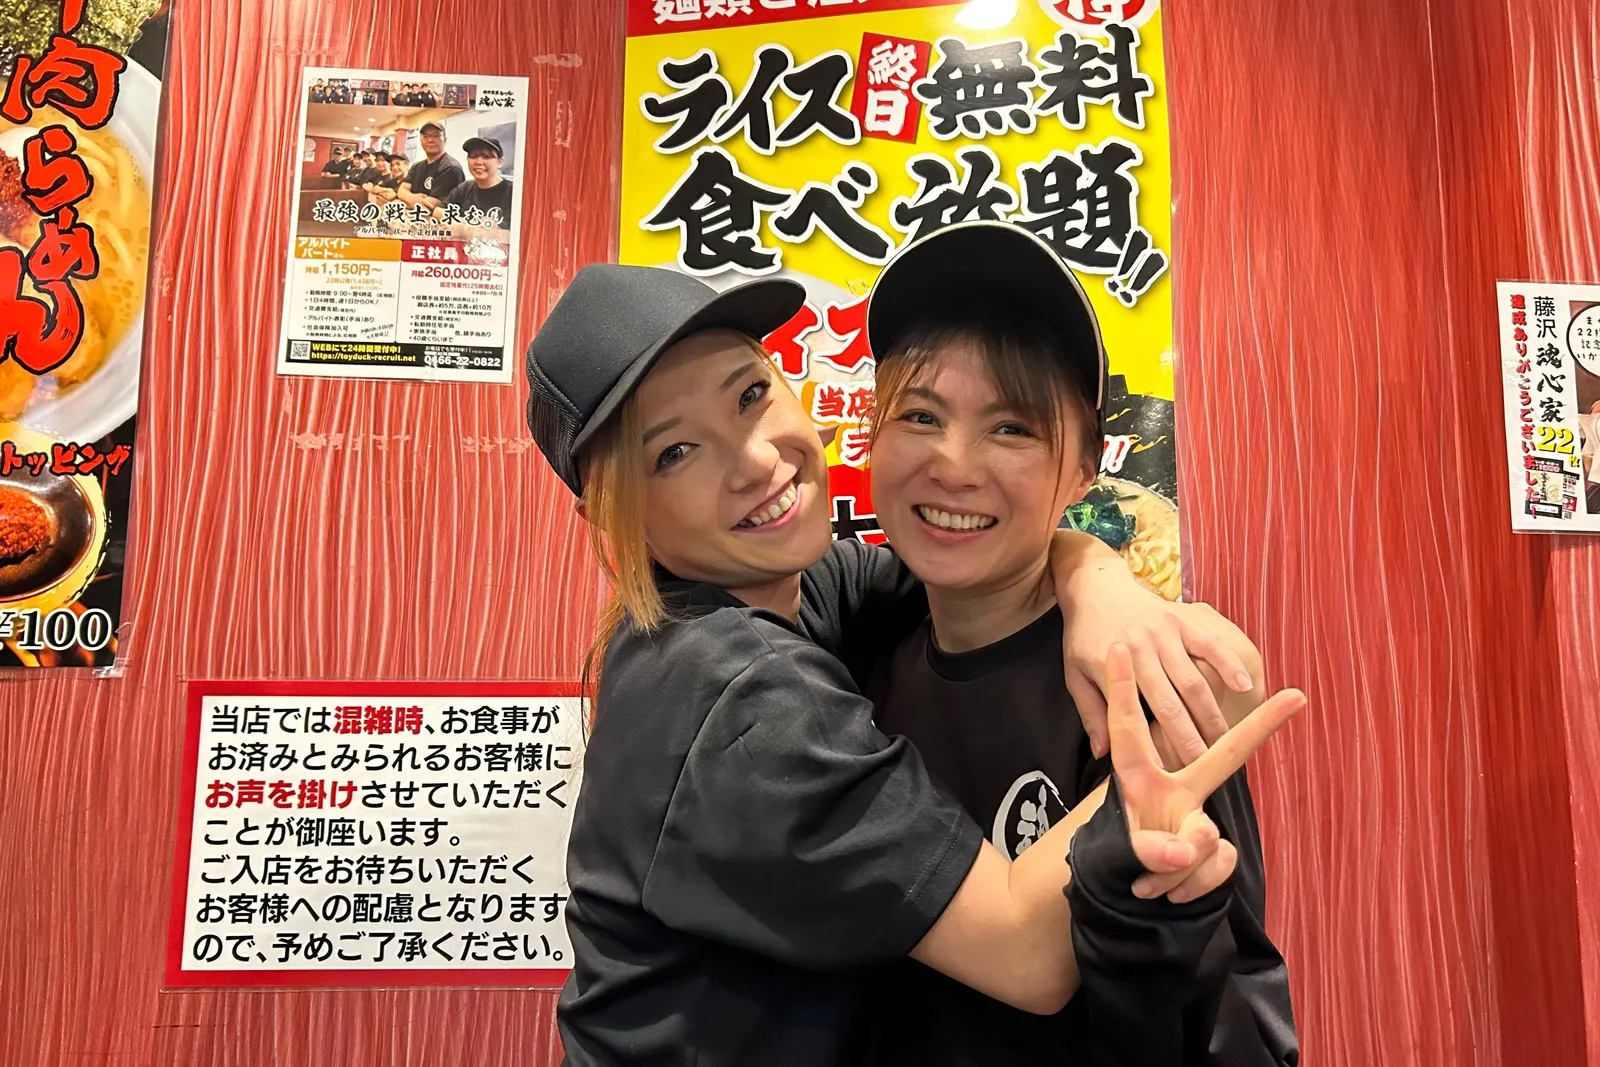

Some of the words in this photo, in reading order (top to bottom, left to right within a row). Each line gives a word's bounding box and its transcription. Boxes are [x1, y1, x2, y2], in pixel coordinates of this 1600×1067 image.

[641, 44, 861, 155] ライス
[866, 40, 930, 138] 終日
[914, 23, 1153, 142] 無料
[297, 236, 351, 250] アルバイト
[410, 244, 458, 261] 正社員
[311, 352, 417, 362] https://toyduck-recruit.net
[1, 442, 131, 477] トッピング
[210, 704, 560, 736] 当店では混雑時、お食事が
[207, 743, 573, 779] お済みとみられるお客様に
[204, 779, 569, 810] お声を掛けさせていただく
[202, 816, 460, 847] ことが御座います。
[199, 854, 535, 886] ご入店をお待ちいただく
[195, 892, 567, 926] お客様への配慮となります
[191, 931, 564, 964] ので、予めご了承ください。
